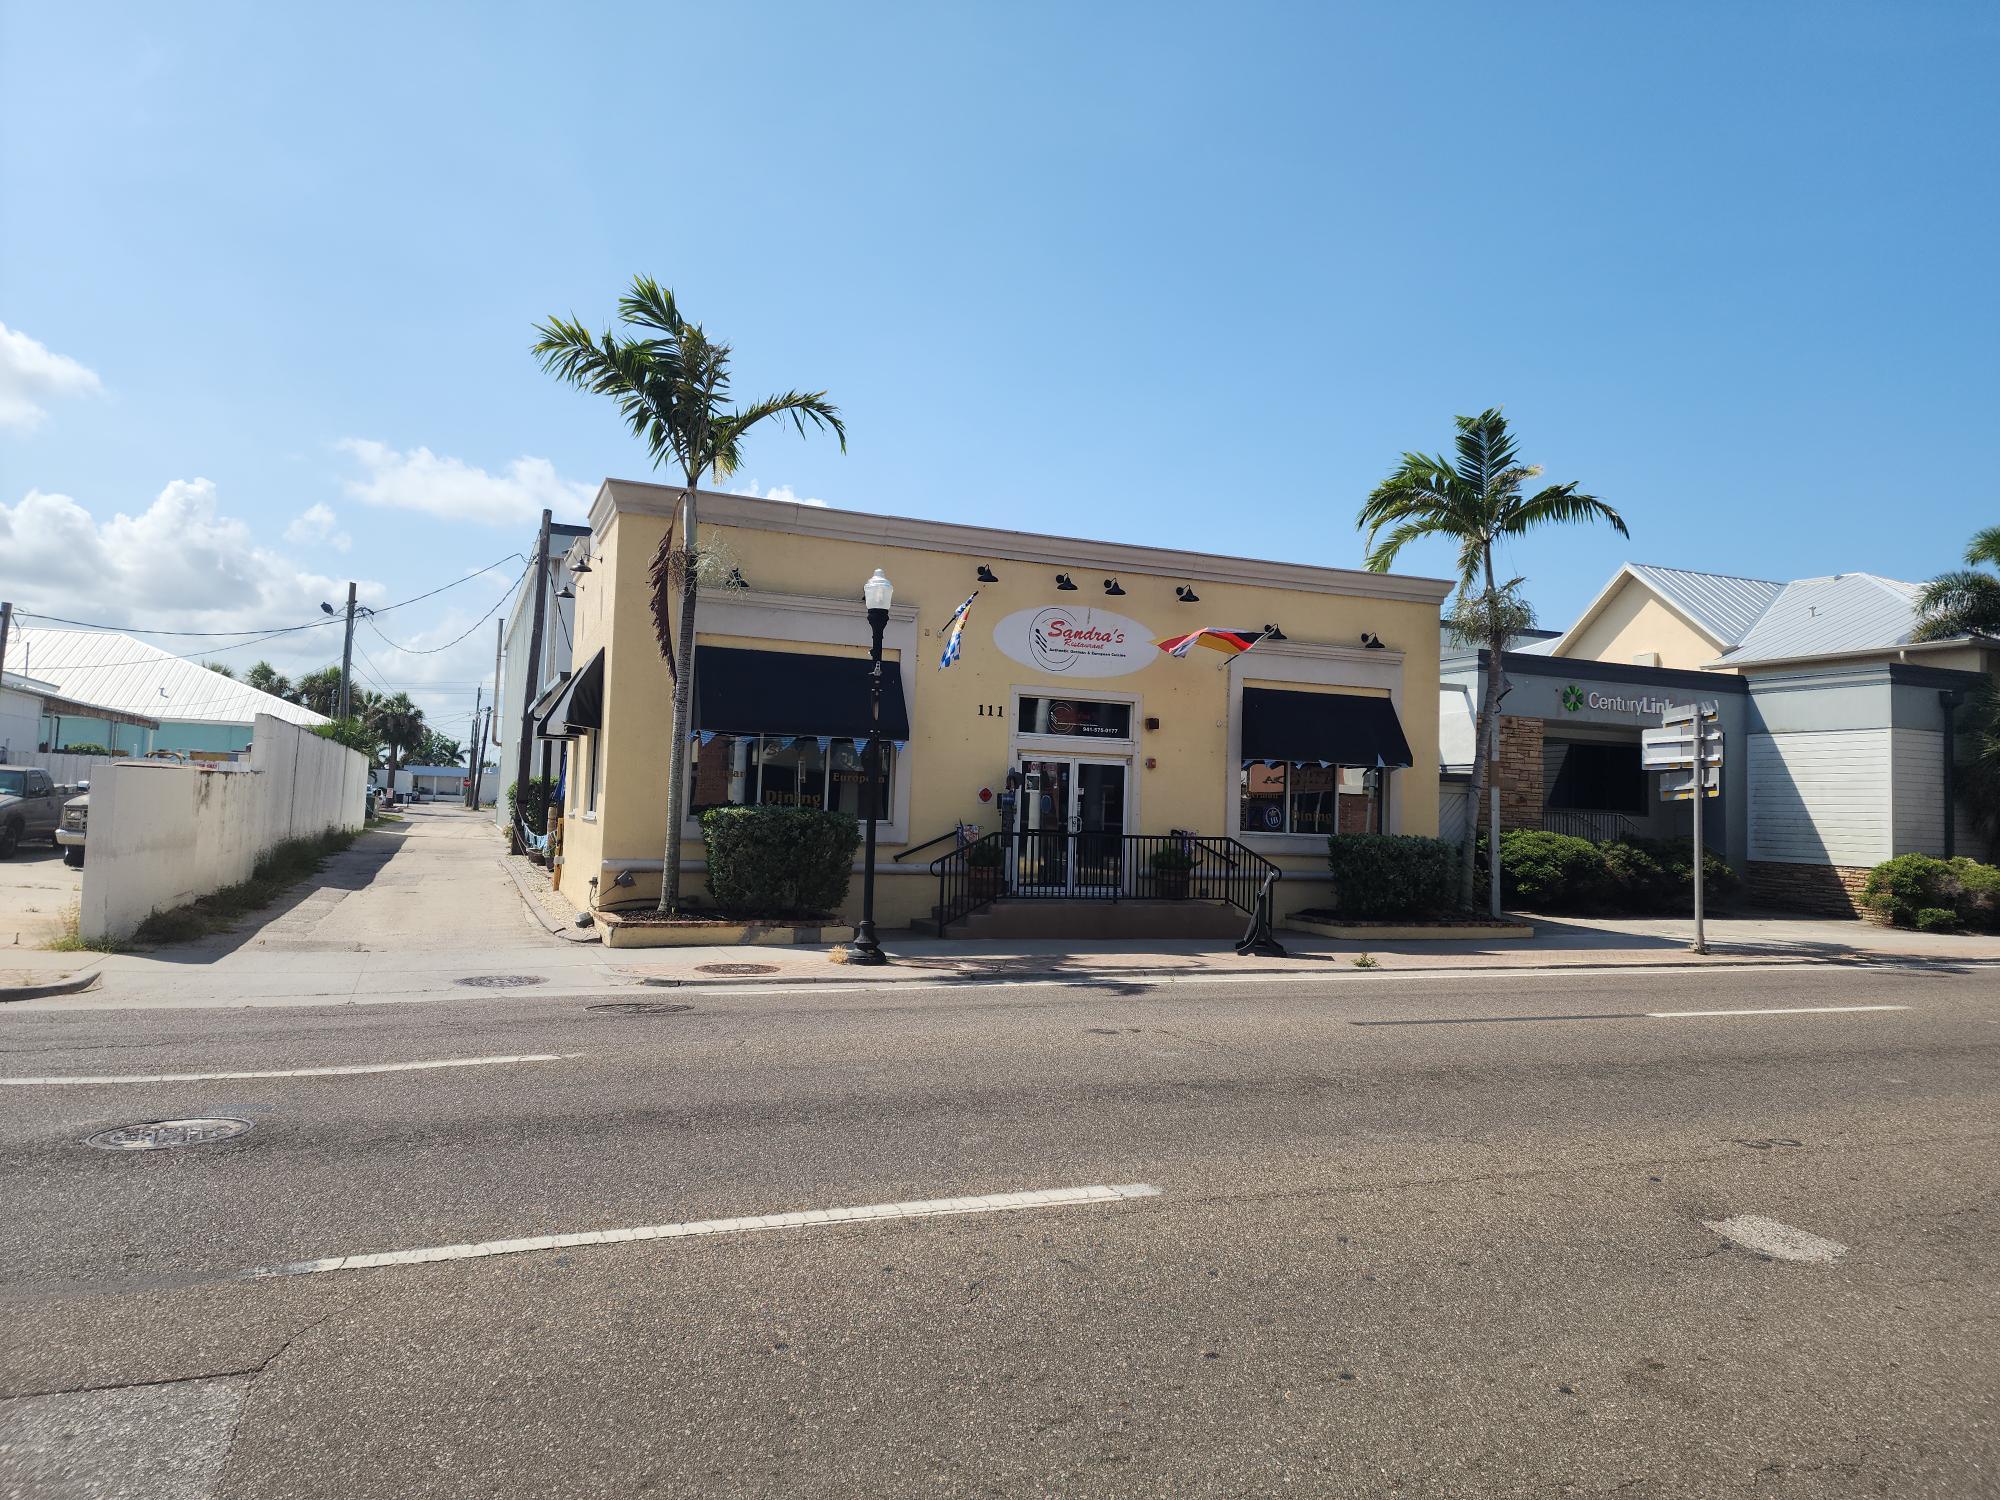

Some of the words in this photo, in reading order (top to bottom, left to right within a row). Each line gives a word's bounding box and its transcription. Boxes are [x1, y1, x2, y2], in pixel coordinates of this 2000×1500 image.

[1048, 620, 1125, 644] Sandra's
[1064, 638, 1104, 650] Restaurant
[977, 704, 1004, 717] 111
[1589, 692, 1674, 715] CenturyLink
[833, 772, 885, 784] Europn
[765, 790, 821, 806] Dining
